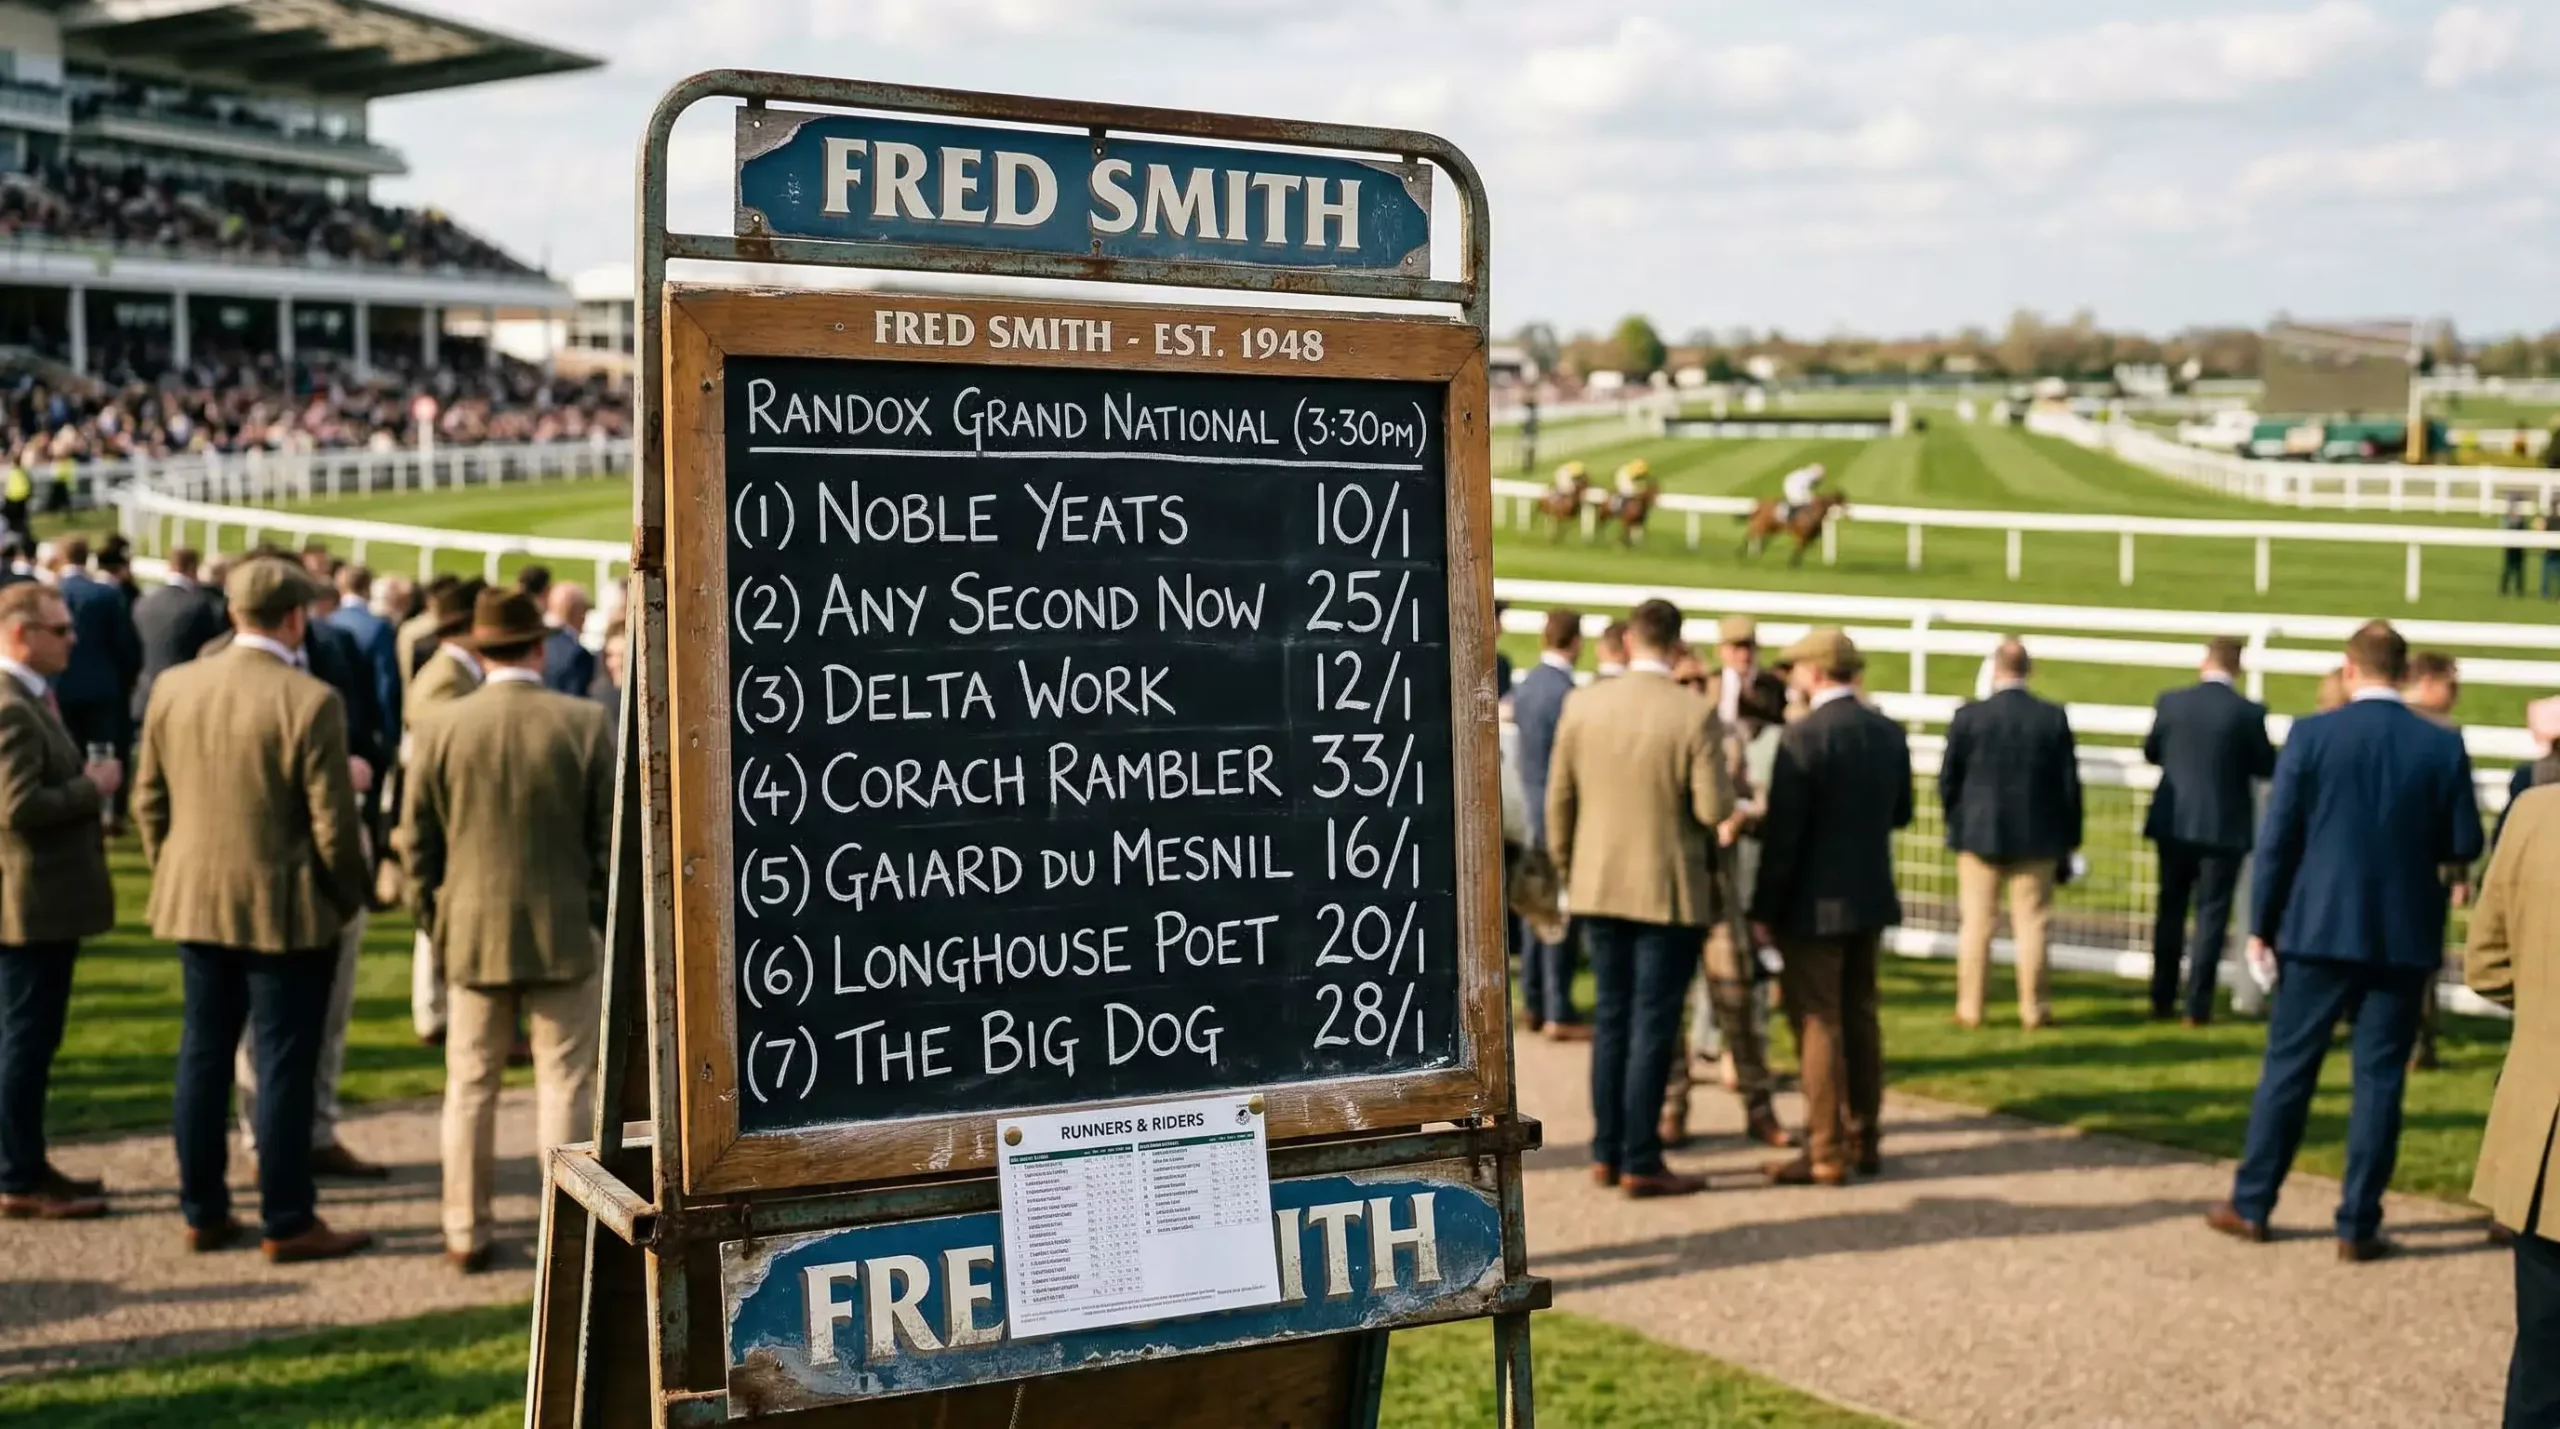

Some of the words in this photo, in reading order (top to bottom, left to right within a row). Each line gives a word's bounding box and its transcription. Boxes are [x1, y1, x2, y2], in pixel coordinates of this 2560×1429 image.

[824, 136, 1058, 227] FRED
[1089, 157, 1362, 252] SMITH
[875, 310, 975, 346] FRED
[989, 315, 1112, 352] SMITH
[1154, 323, 1224, 357] EST.
[1241, 327, 1324, 362] 1948
[747, 378, 933, 436] RANDOX
[953, 386, 1087, 450] GRAND
[1104, 392, 1280, 445] NATIONAL
[734, 481, 795, 551] (1)
[818, 480, 998, 545] NOBLE
[1023, 481, 1188, 552] YEATS
[1317, 480, 1409, 560] 10/1
[734, 574, 801, 645] (2)
[817, 573, 927, 637] ANY
[948, 571, 1139, 635] SECOND
[1157, 572, 1266, 632] NOW
[1305, 569, 1419, 646] 25/1
[736, 665, 805, 735] (3)
[821, 663, 996, 725] DELTA
[1018, 656, 1176, 719] WORK
[1317, 650, 1411, 725] 12/1
[738, 752, 808, 827] (4)
[821, 751, 1025, 814] CORACH
[1048, 742, 1283, 806] RAMBLER
[1312, 733, 1424, 808] 33/1
[741, 844, 810, 919] (5)
[825, 842, 1023, 912] GAIARD
[1040, 849, 1095, 890] DU
[1113, 827, 1294, 887] MESNIL
[1327, 815, 1420, 890] 16/1
[743, 934, 814, 1009] (6)
[834, 926, 1132, 995] LONGHOUSE
[1154, 910, 1280, 973] POET
[1315, 900, 1425, 976] 20/1
[747, 1025, 818, 1103] (7)
[834, 1019, 952, 1085] THE
[981, 1009, 1080, 1078] BIG
[1103, 1002, 1224, 1067] DOG
[1313, 981, 1424, 1058] 28/1
[1061, 1119, 1133, 1140] RUNNERS
[1136, 1118, 1149, 1132] &
[1152, 1112, 1205, 1131] RIDERS
[803, 1244, 1006, 1367] FRE
[1275, 1191, 1443, 1301] ITH
